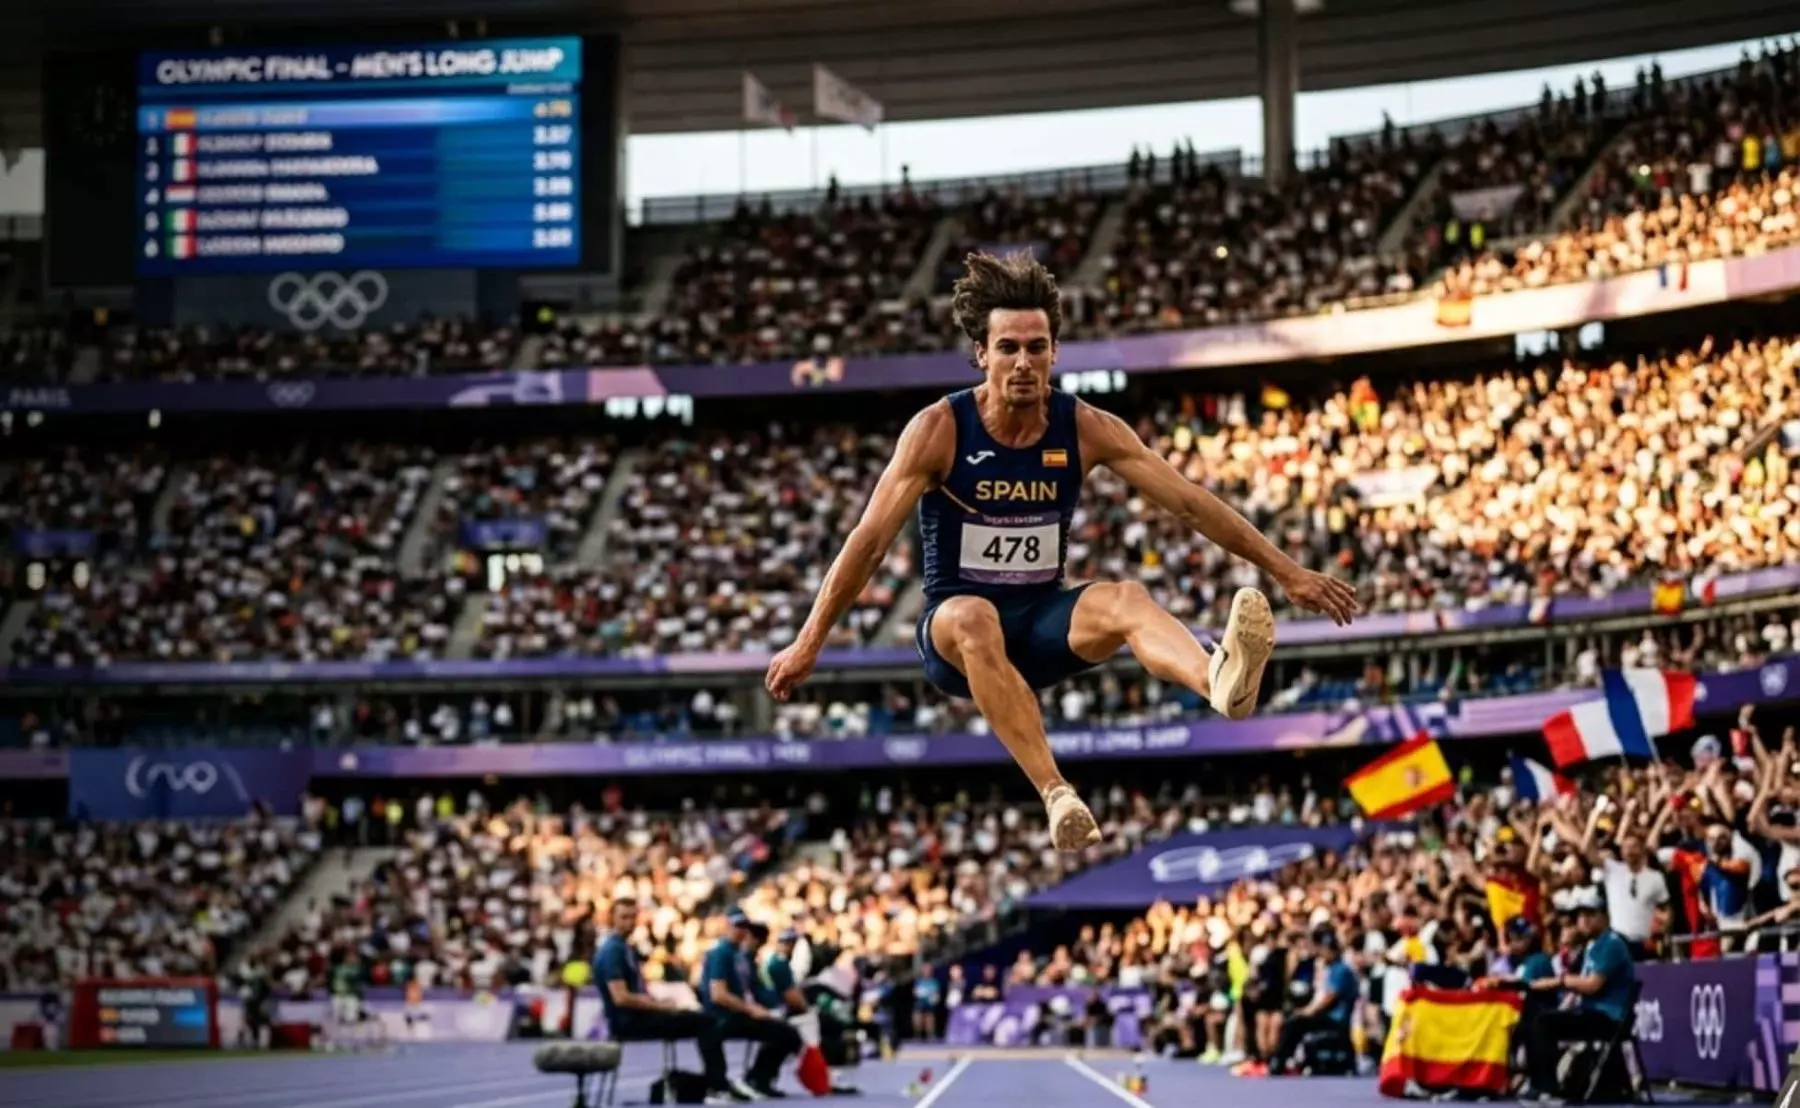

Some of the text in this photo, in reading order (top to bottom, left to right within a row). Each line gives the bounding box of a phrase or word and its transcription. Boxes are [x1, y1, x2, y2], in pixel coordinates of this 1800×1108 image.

[157, 57, 263, 83] OLYMPIC
[264, 54, 332, 80] FINAL
[425, 49, 496, 75] LONG
[499, 47, 564, 73] JUMP
[975, 480, 1057, 501] SPAIN
[982, 536, 1040, 563] 478
